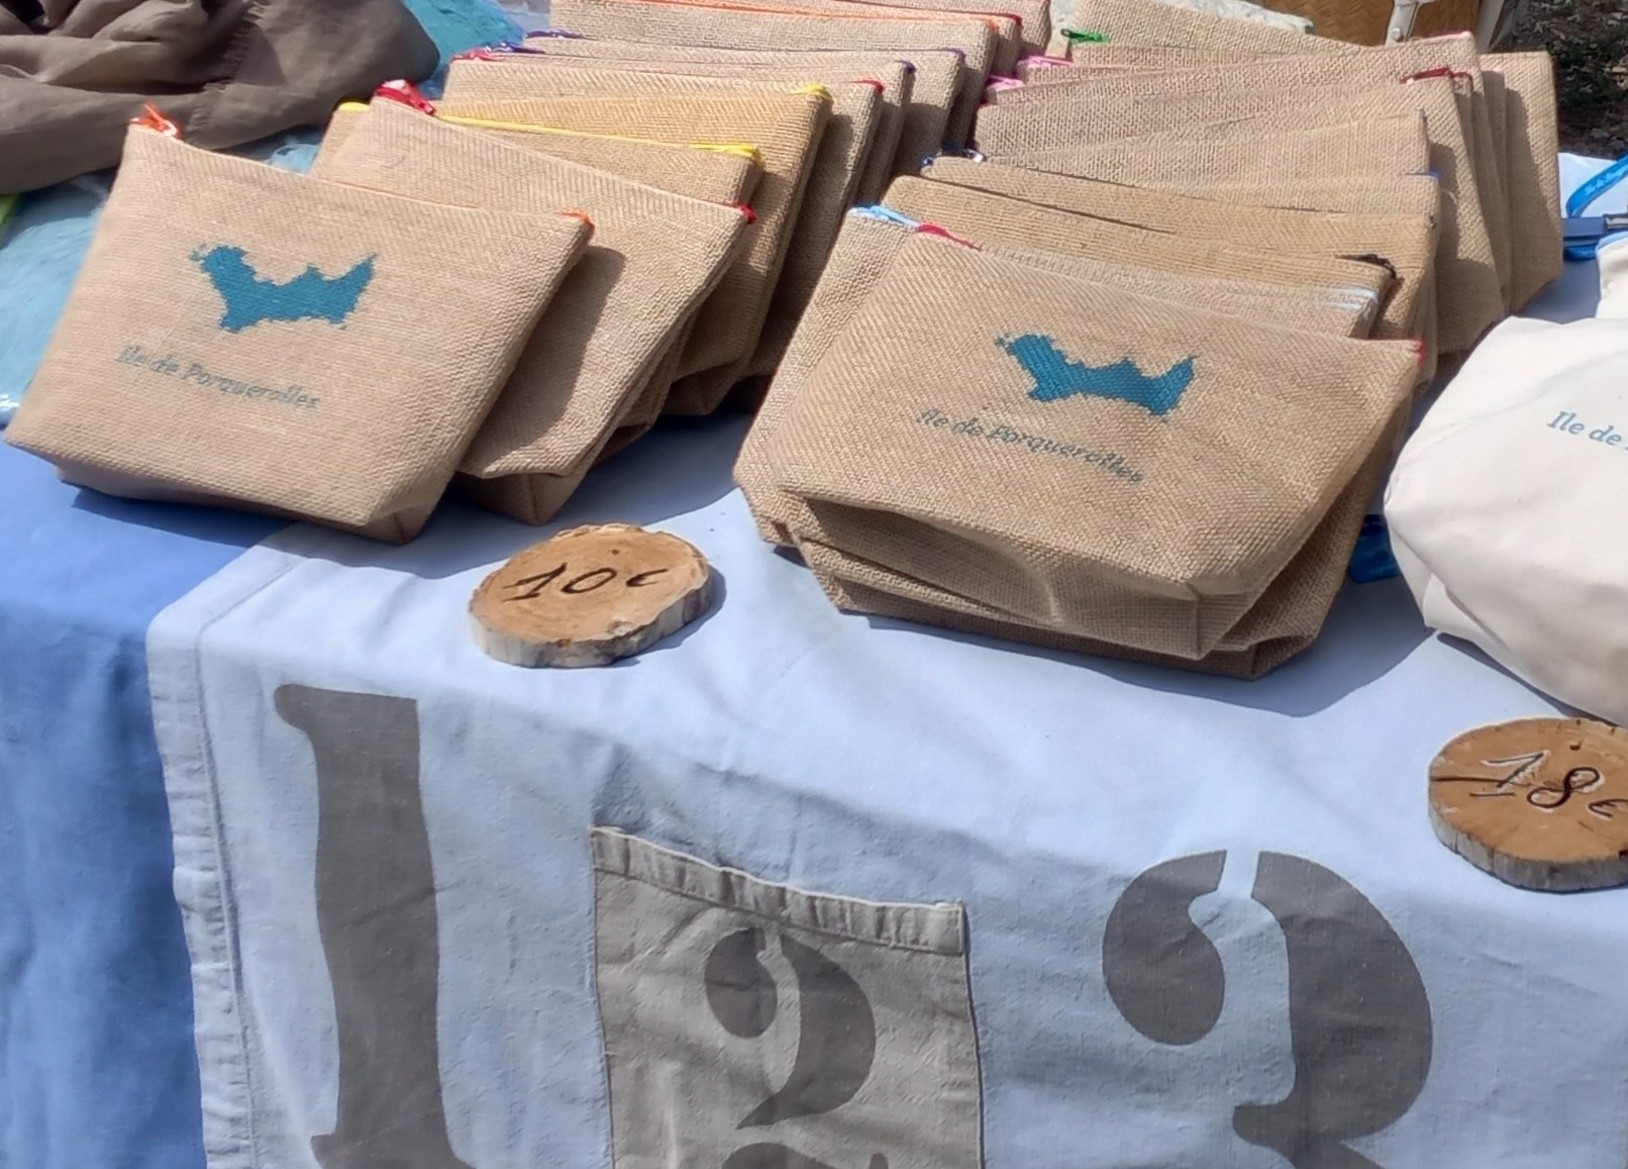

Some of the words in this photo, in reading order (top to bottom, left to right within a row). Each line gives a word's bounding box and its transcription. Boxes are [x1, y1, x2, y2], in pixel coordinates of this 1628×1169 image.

[152, 353, 181, 376] de
[183, 362, 321, 409] Porquerolles
[953, 417, 985, 436] de
[987, 426, 1143, 483] Porquerolles
[1547, 411, 1585, 435] Ile
[1588, 425, 1622, 446] de
